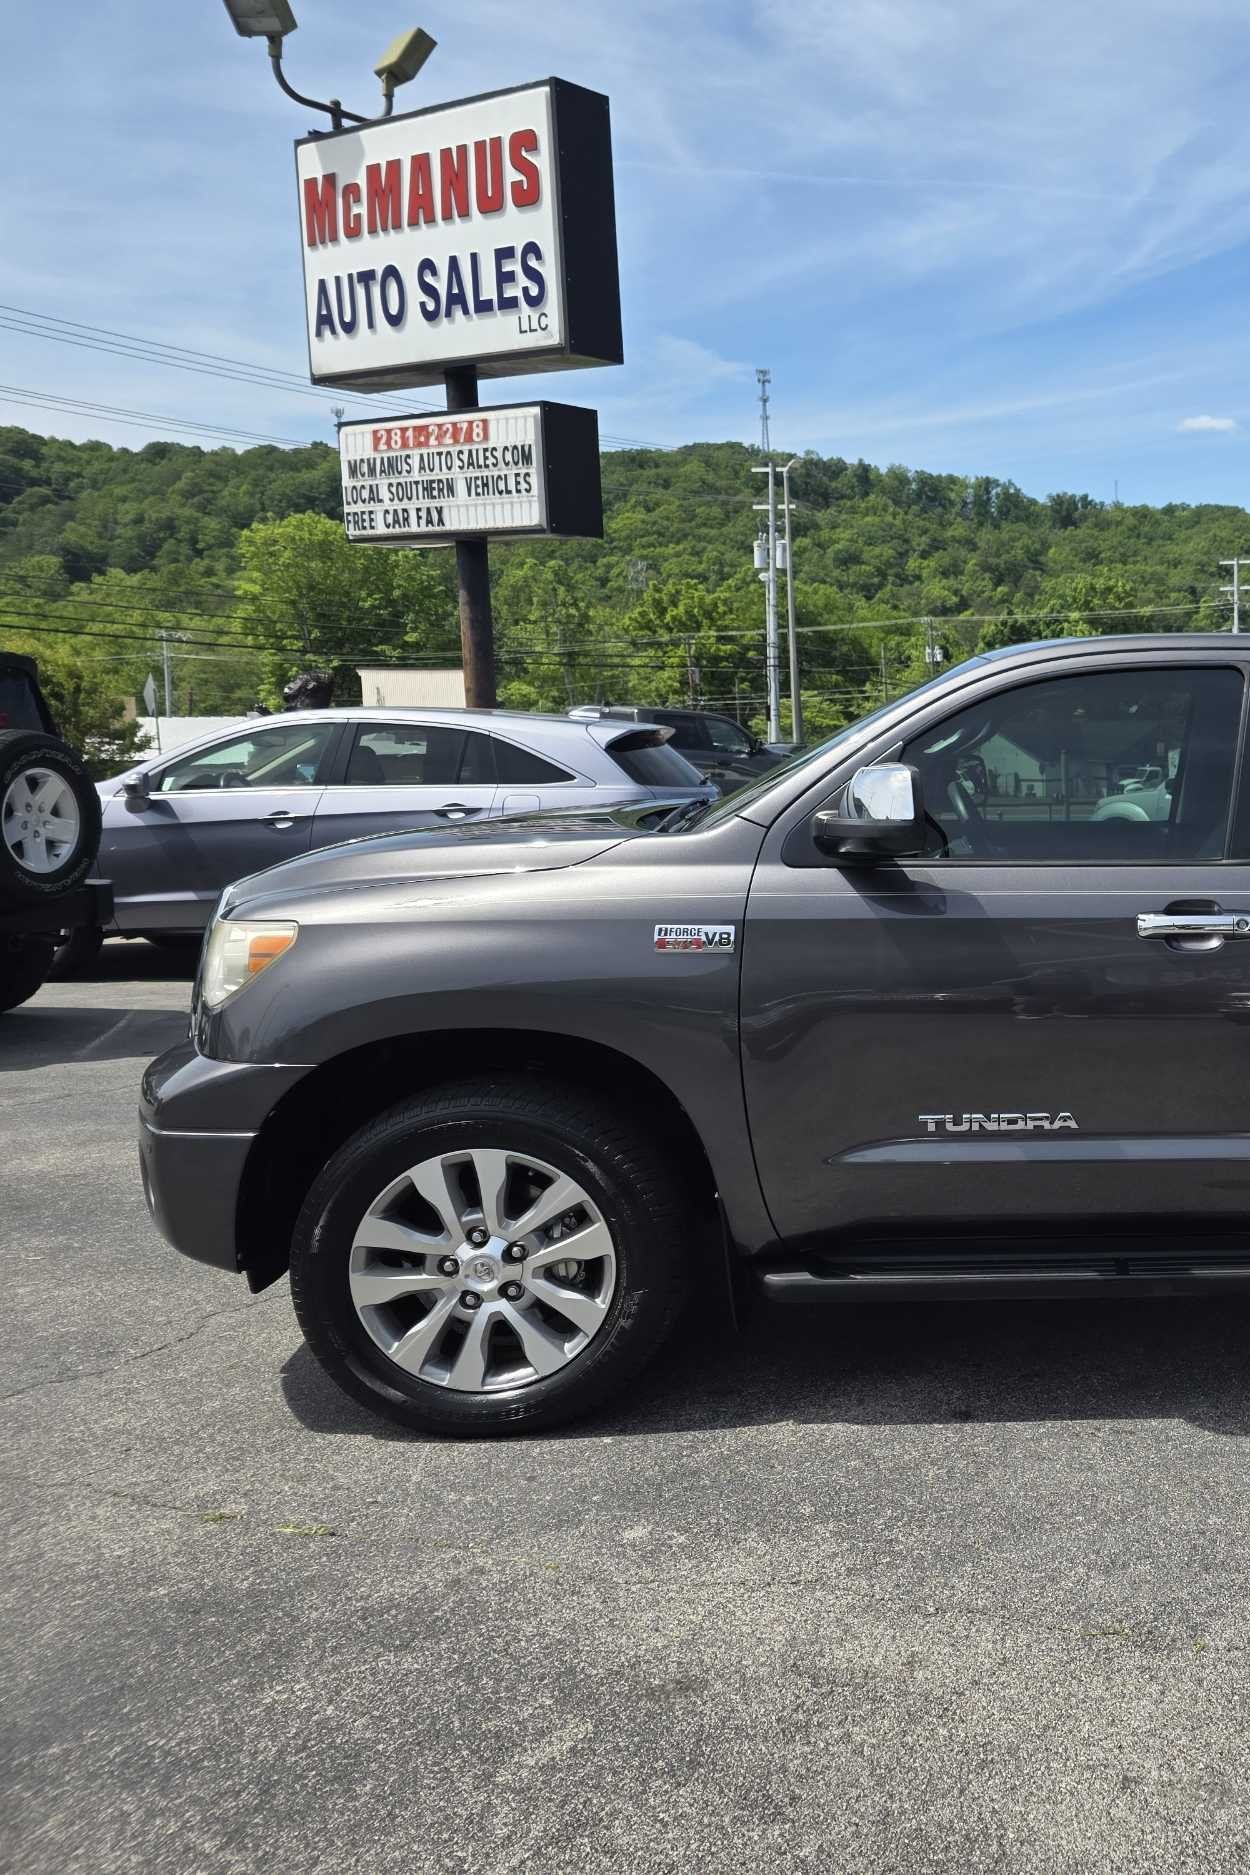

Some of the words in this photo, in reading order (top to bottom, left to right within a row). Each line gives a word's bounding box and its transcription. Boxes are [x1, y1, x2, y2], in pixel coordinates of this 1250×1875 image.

[304, 128, 541, 247] McMANUS
[315, 263, 405, 338] AUTO
[417, 241, 546, 323] SALES
[518, 312, 550, 334] LLC
[347, 453, 412, 480] MCMANUS
[344, 482, 385, 506] LOCAL
[388, 477, 456, 502] SOUTHERN
[464, 472, 532, 498] VEHICLES
[345, 510, 376, 532] FREE
[383, 507, 411, 529] CAR
[416, 506, 446, 528] FAX
[917, 1112, 1081, 1132] TUNDRA
